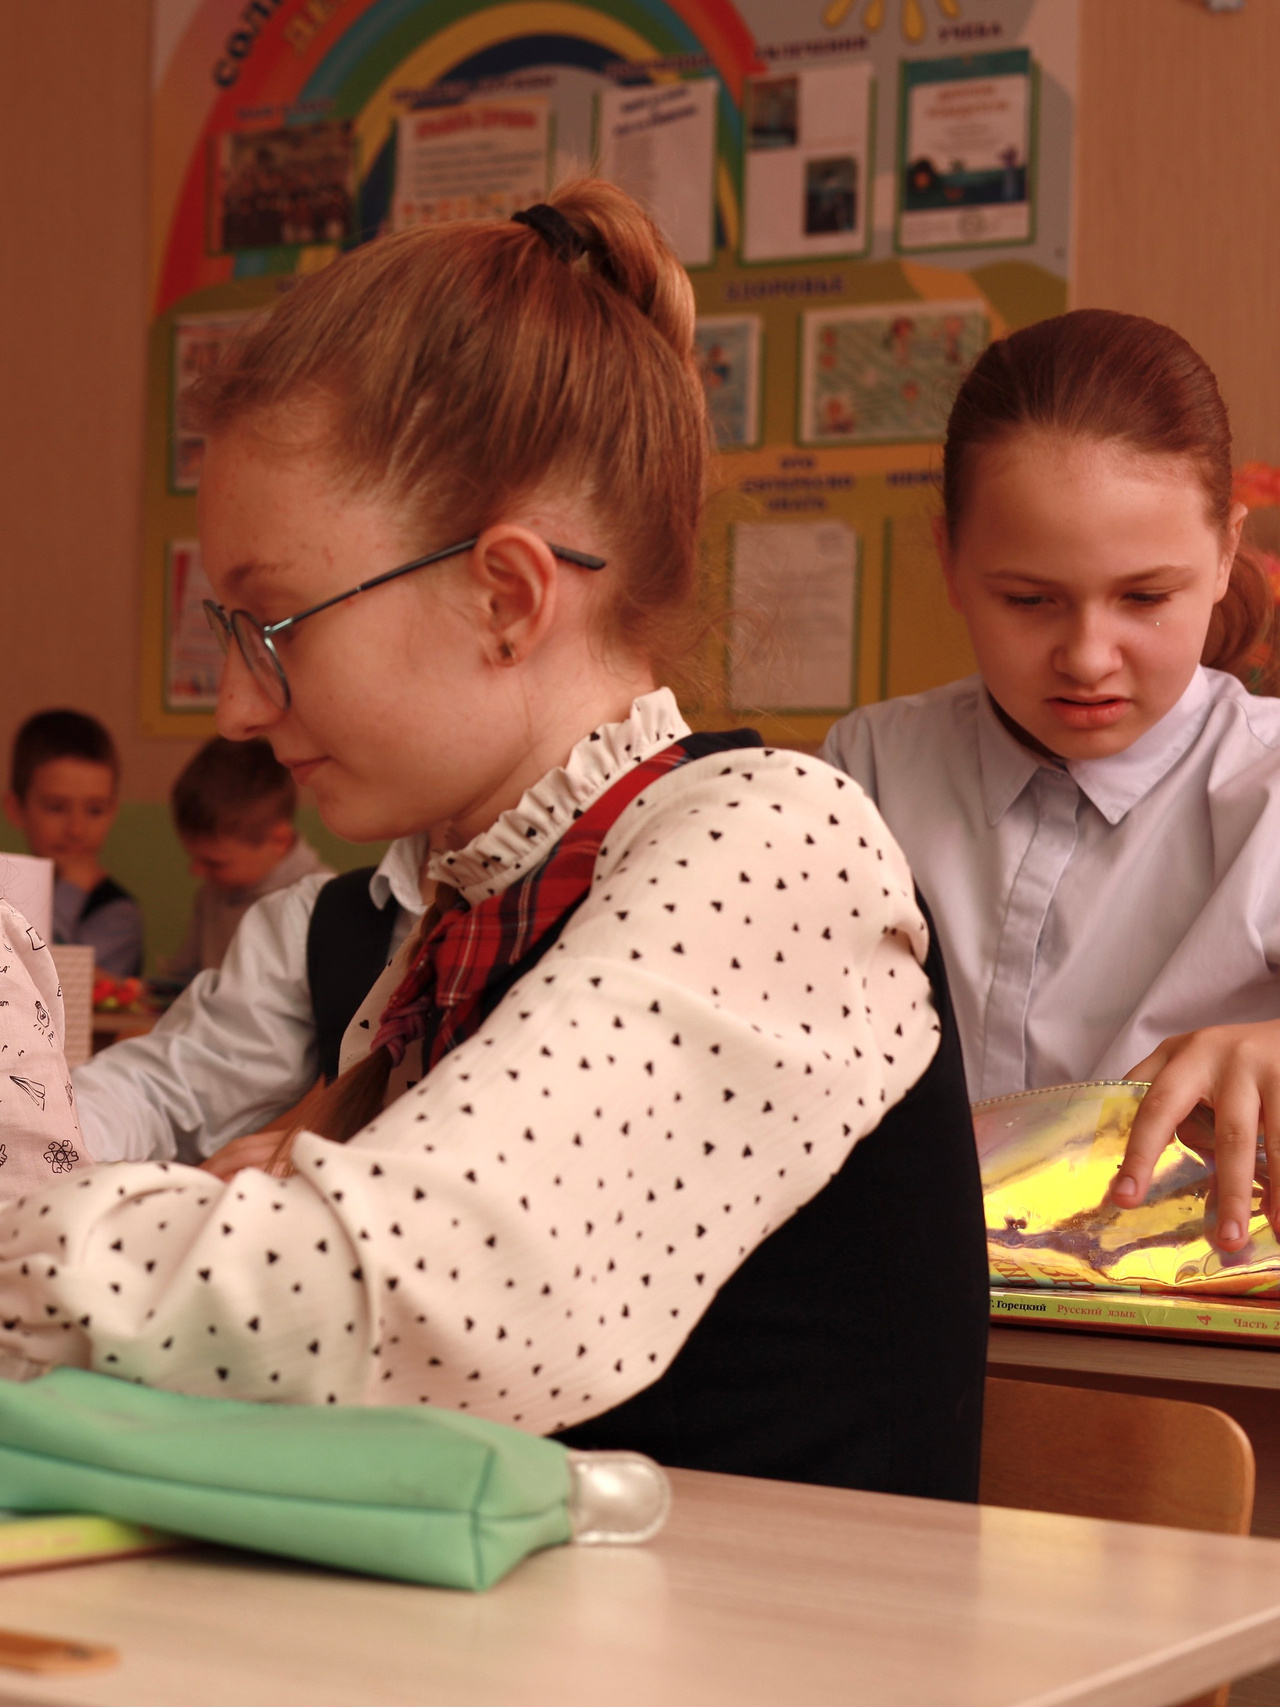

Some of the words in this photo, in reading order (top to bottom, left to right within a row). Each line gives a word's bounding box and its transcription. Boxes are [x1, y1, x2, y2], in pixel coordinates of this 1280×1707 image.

[997, 1300, 1047, 1313] Горецкий
[1057, 1304, 1103, 1320] Русский
[1107, 1309, 1136, 1319] язык
[1196, 1314, 1212, 1326] 4
[1233, 1318, 1268, 1331] Часть
[1273, 1320, 1280, 1331] 2
